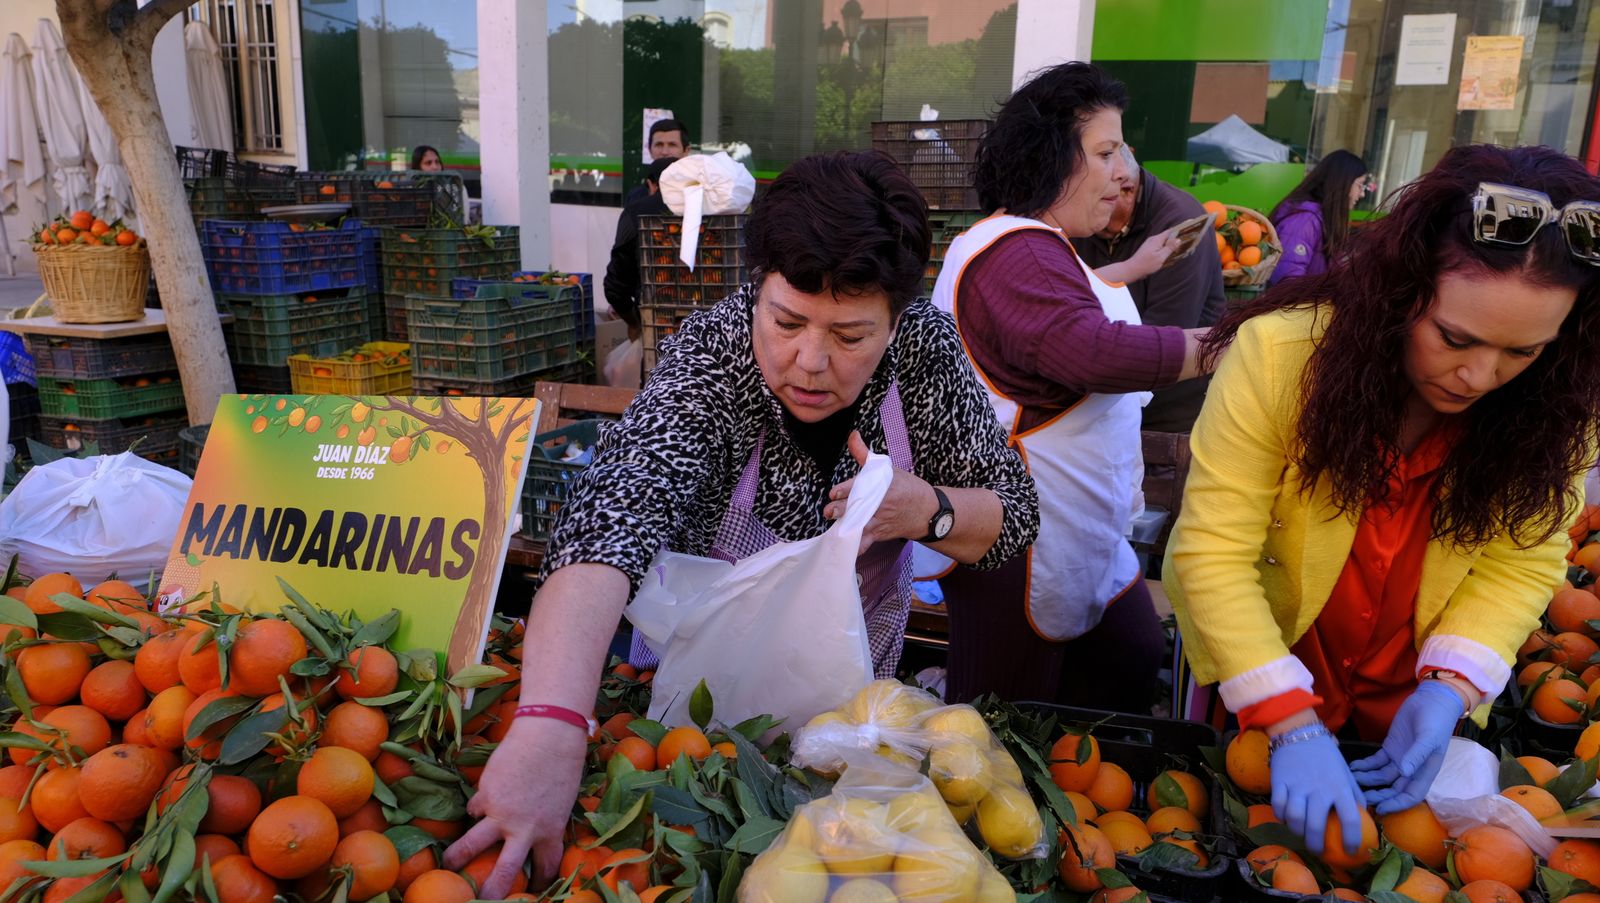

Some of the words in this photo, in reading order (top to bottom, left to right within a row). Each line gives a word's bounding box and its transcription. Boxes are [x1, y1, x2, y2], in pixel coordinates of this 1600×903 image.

[313, 444, 353, 463] JUAN
[354, 442, 391, 465] DÍAZ
[316, 467, 348, 479] DESDE
[350, 467, 375, 480] 1966
[180, 502, 481, 580] MANDARINAS
